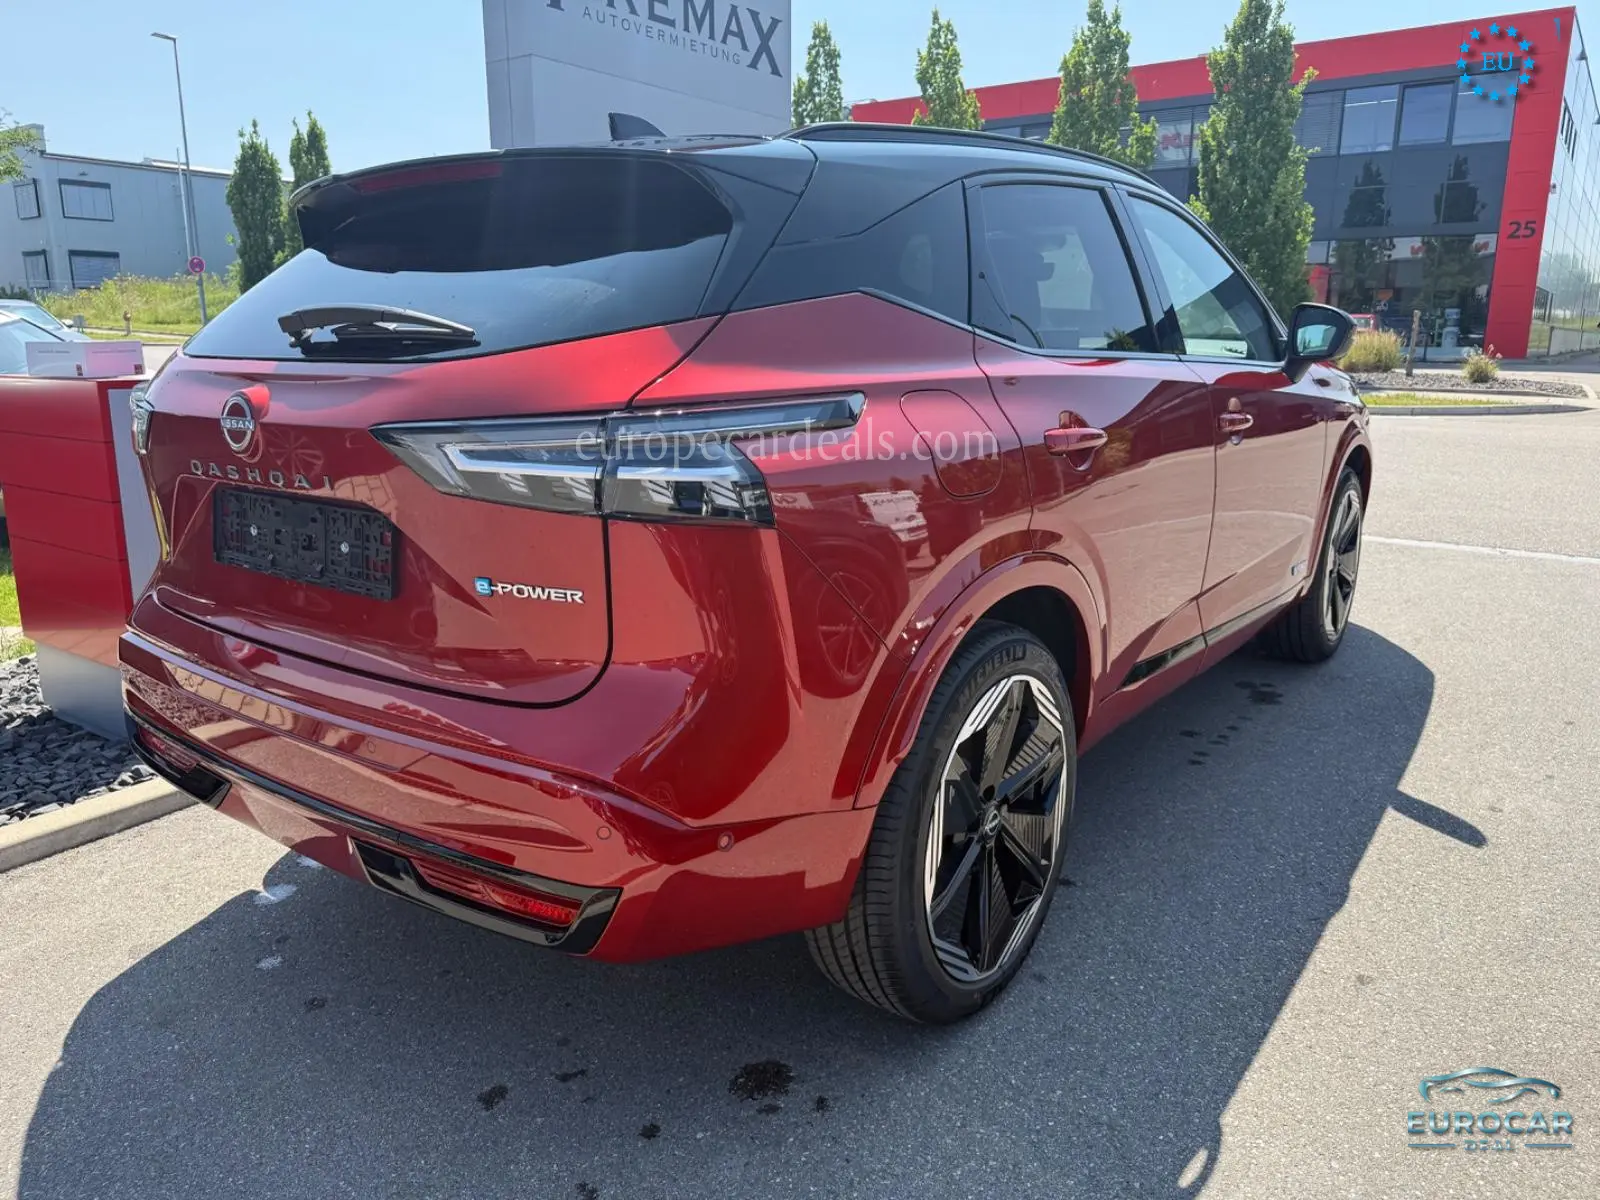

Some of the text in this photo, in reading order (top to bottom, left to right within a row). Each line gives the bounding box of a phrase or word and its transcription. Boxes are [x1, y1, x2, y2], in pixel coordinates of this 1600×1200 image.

[547, 0, 783, 78] EMAX
[582, 6, 741, 65] AUTOVERMIETUNG
[1507, 220, 1537, 239] 25
[190, 459, 333, 491] QASHQAI
